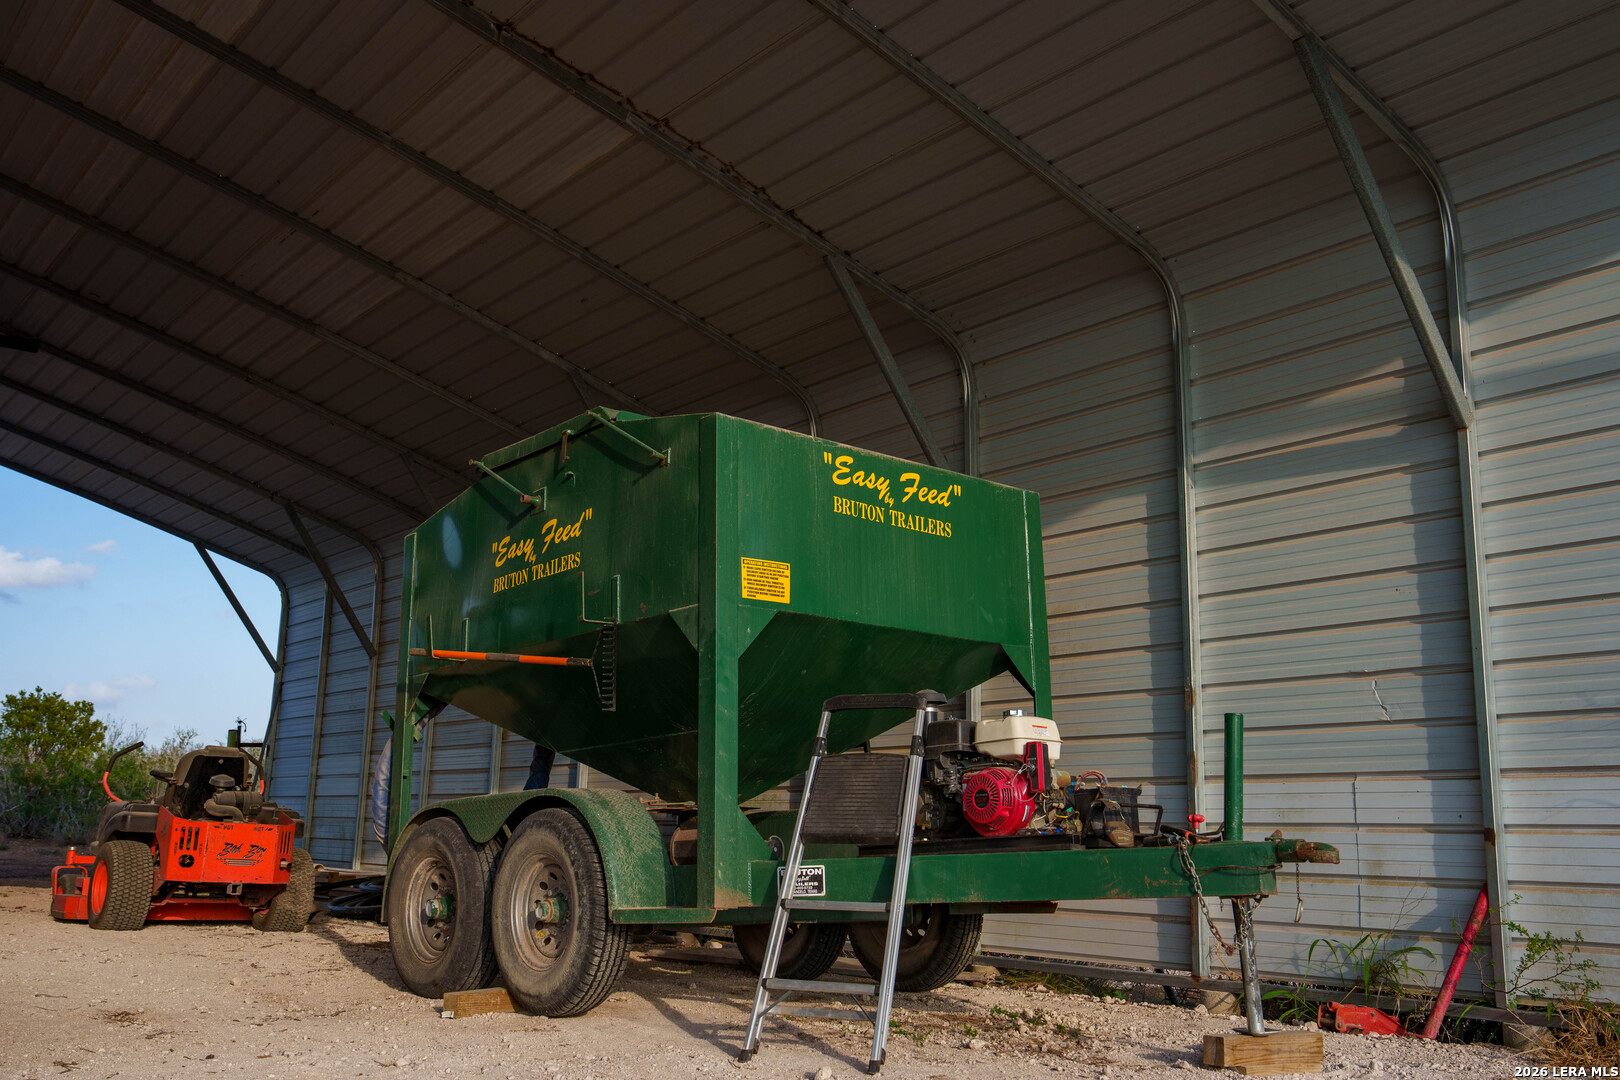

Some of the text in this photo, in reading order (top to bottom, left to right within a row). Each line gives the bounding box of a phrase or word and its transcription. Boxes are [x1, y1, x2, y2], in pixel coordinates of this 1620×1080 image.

[823, 451, 962, 508] "Easy Feed"
[884, 492, 895, 508] by
[492, 507, 593, 568] "Easy Feed"
[833, 495, 952, 538] BRUTON TRAILERS
[492, 551, 581, 594] BRUTON TRAILERS
